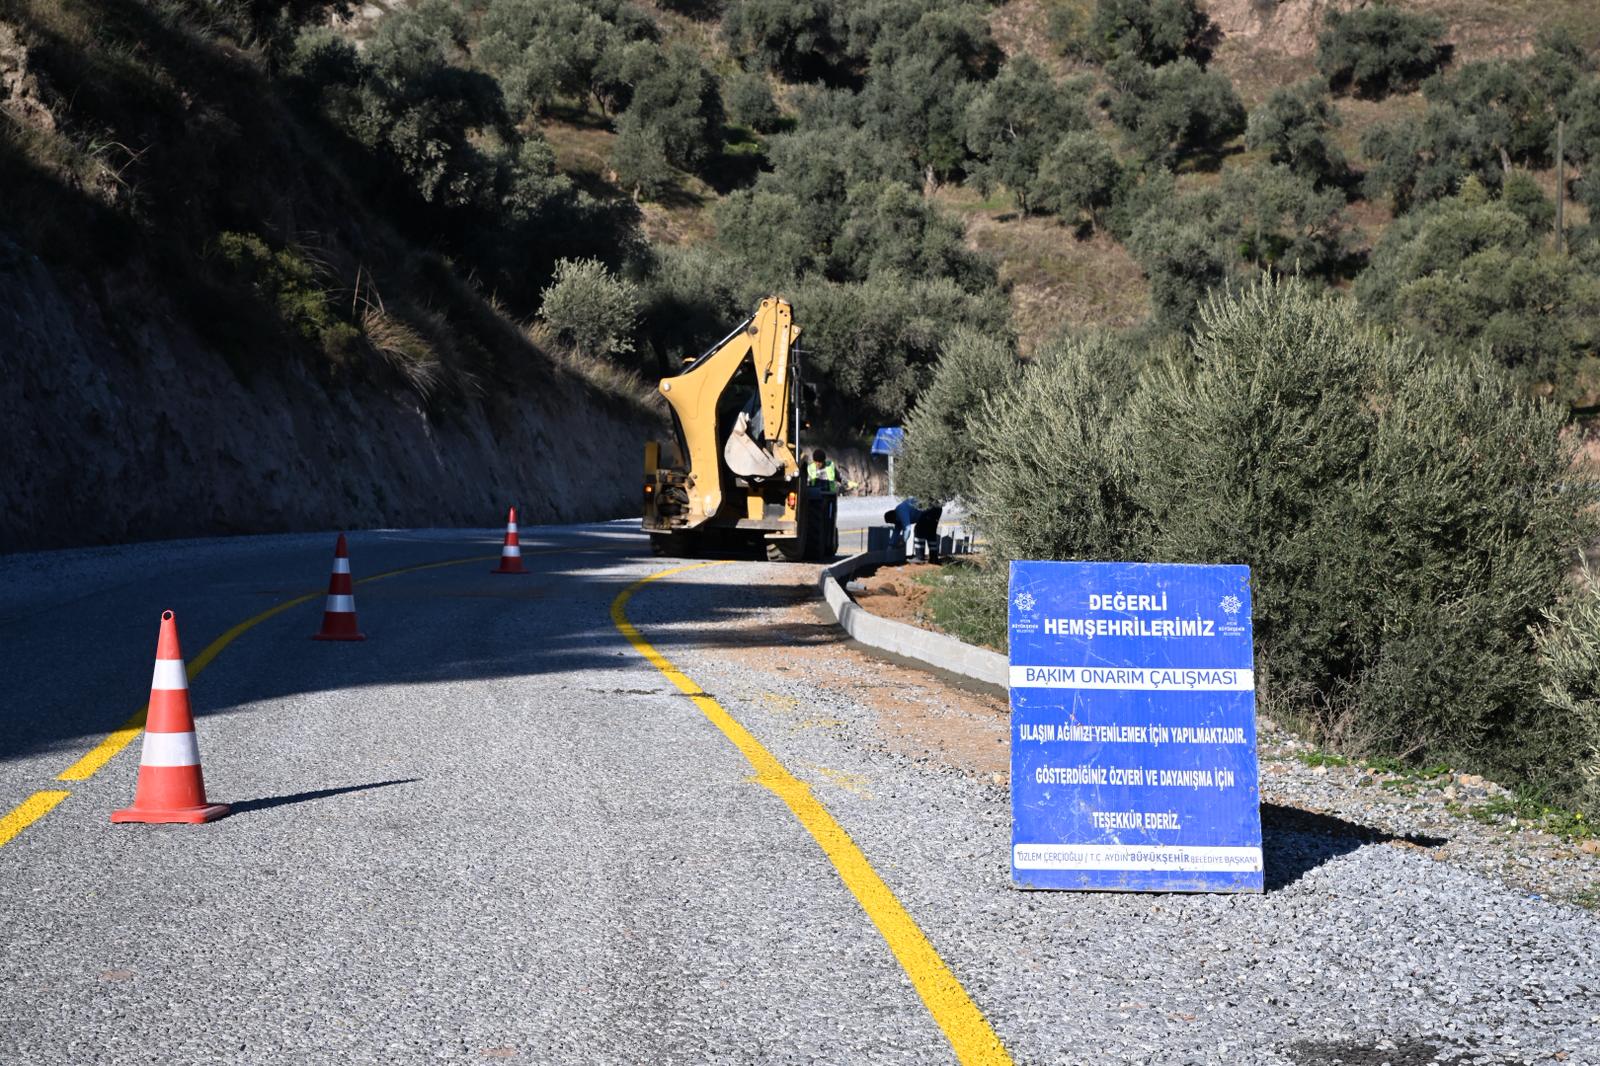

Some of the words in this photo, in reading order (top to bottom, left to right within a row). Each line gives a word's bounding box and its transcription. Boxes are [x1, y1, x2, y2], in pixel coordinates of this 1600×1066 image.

[1089, 591, 1168, 611] DEĞERLİ
[1044, 616, 1215, 639] HEMŞEHRİLERİMİZ
[1026, 667, 1076, 683] BAKIM
[1081, 668, 1145, 684] ONARIM
[1150, 670, 1238, 689] ÇALIŞMASI
[1020, 723, 1055, 744] ULAŞIM
[1094, 722, 1148, 743] YENİLEMEK
[1149, 723, 1169, 747] İÇİN
[1170, 727, 1247, 743] YAPILMAKTADIR.
[1035, 764, 1108, 785] GÖSTERDİĞİNİZ
[1109, 765, 1144, 786] ÖZVERİ
[1145, 769, 1158, 786] VE
[1159, 770, 1213, 791] DAYANIŞMA
[1214, 766, 1235, 792] İÇİN
[1092, 808, 1143, 833] TEŞEKKÜR
[1144, 809, 1182, 830] EDERİZ.
[1104, 853, 1129, 862] AYDIN
[1130, 850, 1190, 865] BÜYÜKŞEHİR
